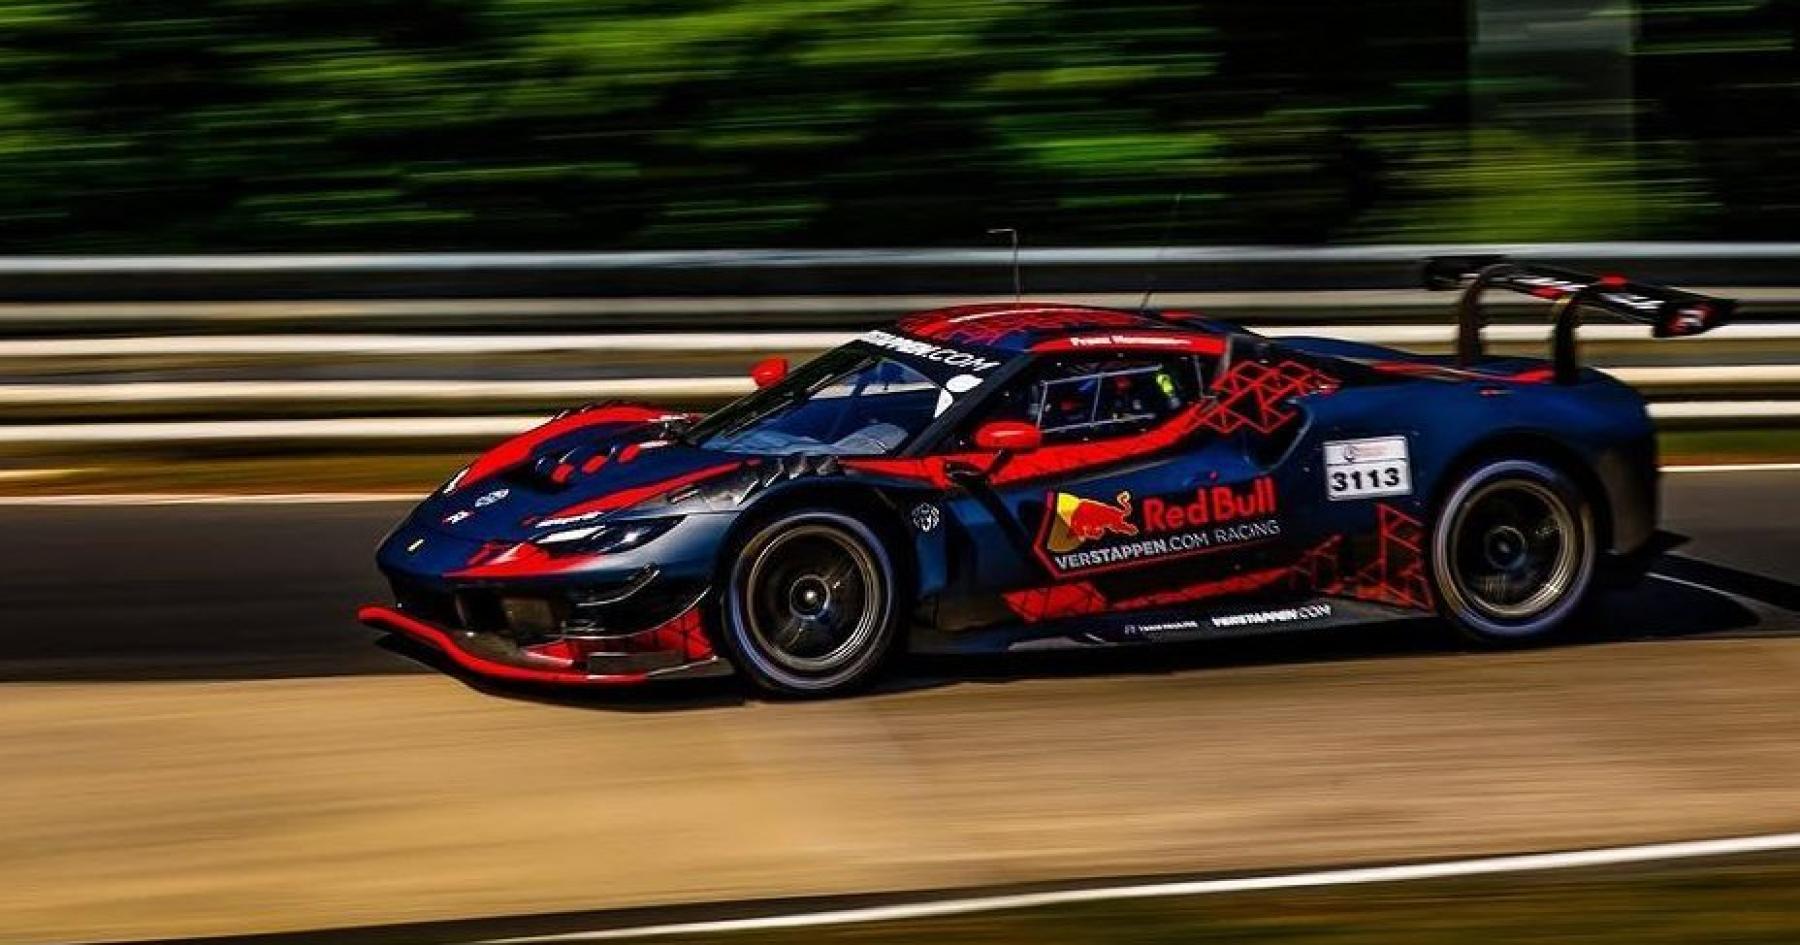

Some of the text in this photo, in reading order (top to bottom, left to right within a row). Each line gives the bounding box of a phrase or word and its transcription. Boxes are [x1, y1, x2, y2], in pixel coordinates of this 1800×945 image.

[1142, 475, 1277, 532] Red Bull
[1330, 466, 1401, 492] 3113
[1054, 519, 1281, 570] VERSTAPPEN.COM RACING
